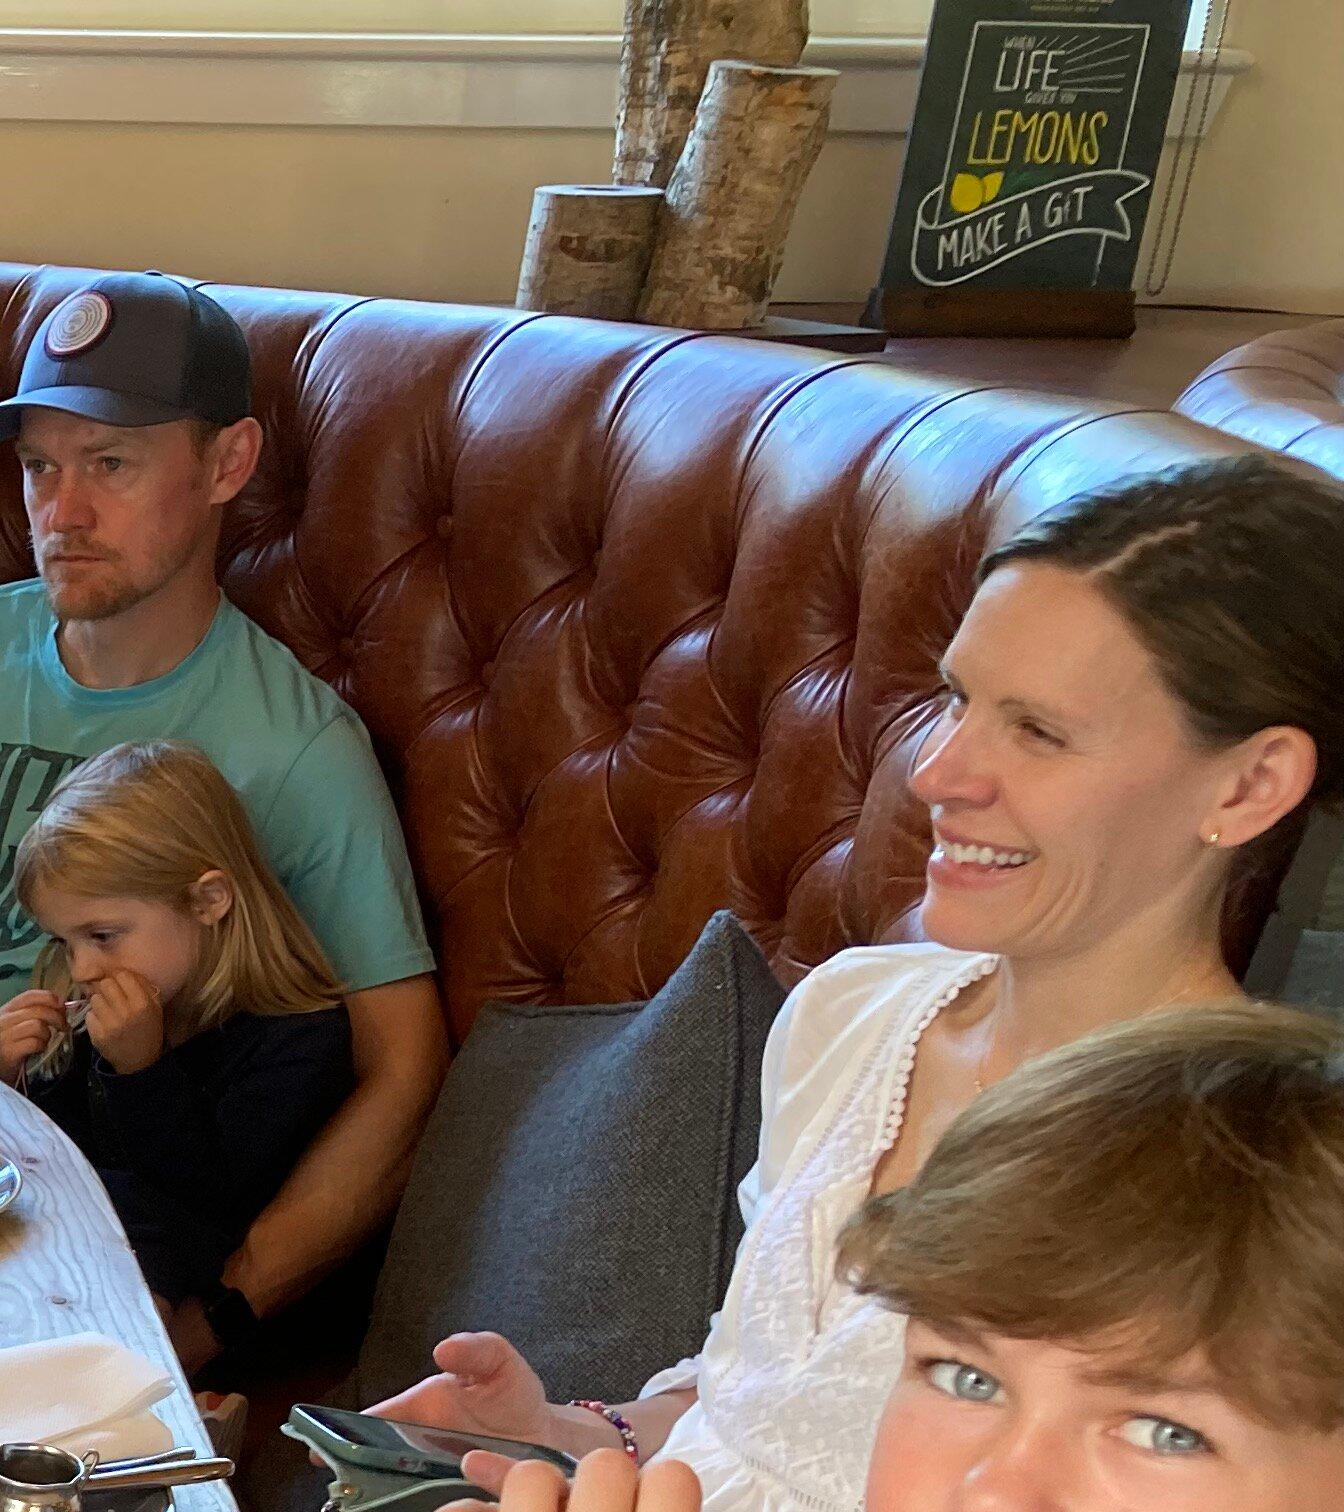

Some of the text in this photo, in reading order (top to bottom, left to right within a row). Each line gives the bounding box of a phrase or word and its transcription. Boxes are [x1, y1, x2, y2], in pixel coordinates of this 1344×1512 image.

[994, 50, 1066, 92] LIFE
[967, 109, 1108, 165] LEMONS
[937, 211, 1008, 270] MAKE
[1014, 202, 1032, 244] A
